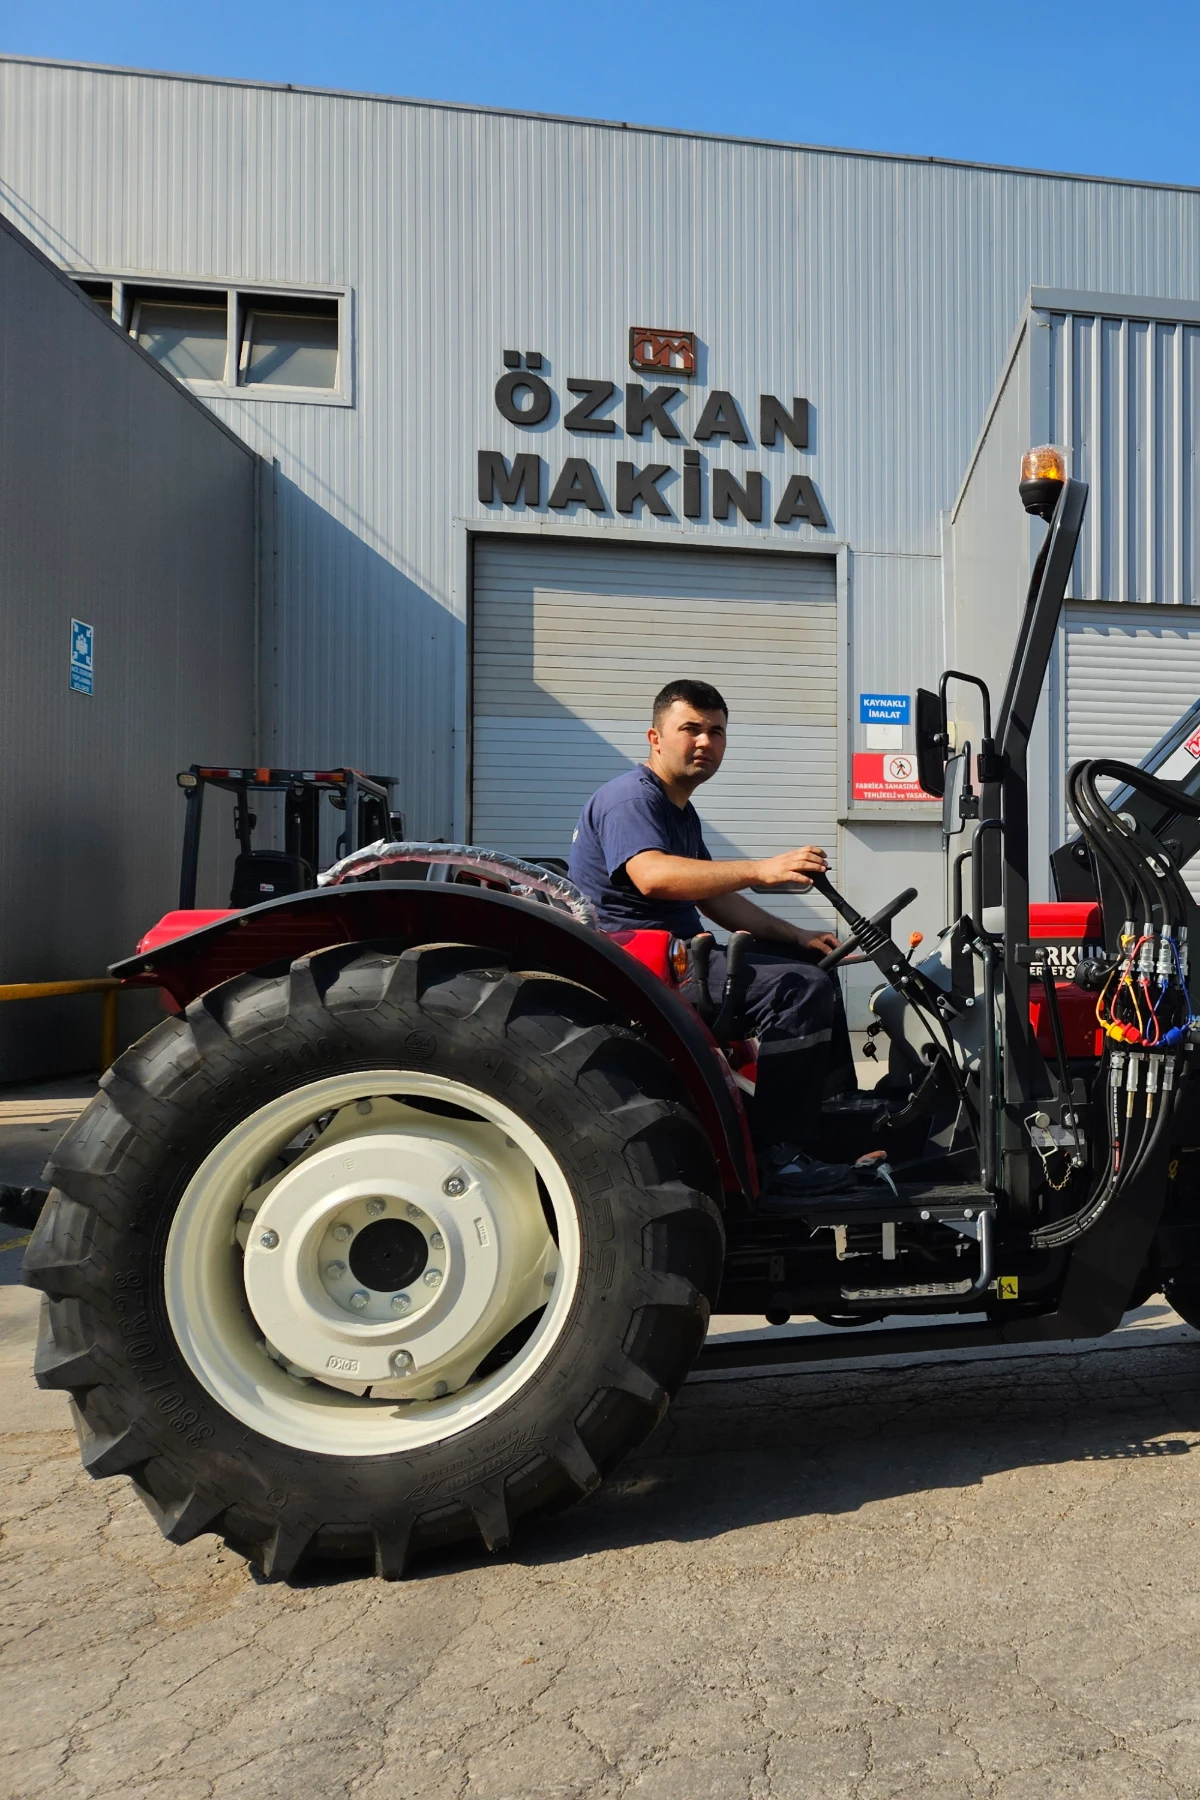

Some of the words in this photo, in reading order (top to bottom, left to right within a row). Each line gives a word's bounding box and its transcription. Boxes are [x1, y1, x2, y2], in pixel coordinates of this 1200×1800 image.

[494, 349, 809, 449] ÖZKAN
[477, 449, 828, 527] MAKİNA
[863, 698, 906, 708] KAYNAKLI
[868, 708, 901, 719] İMALAT
[855, 781, 884, 790] FABRİKA
[863, 790, 896, 799] TEHLİKELİ
